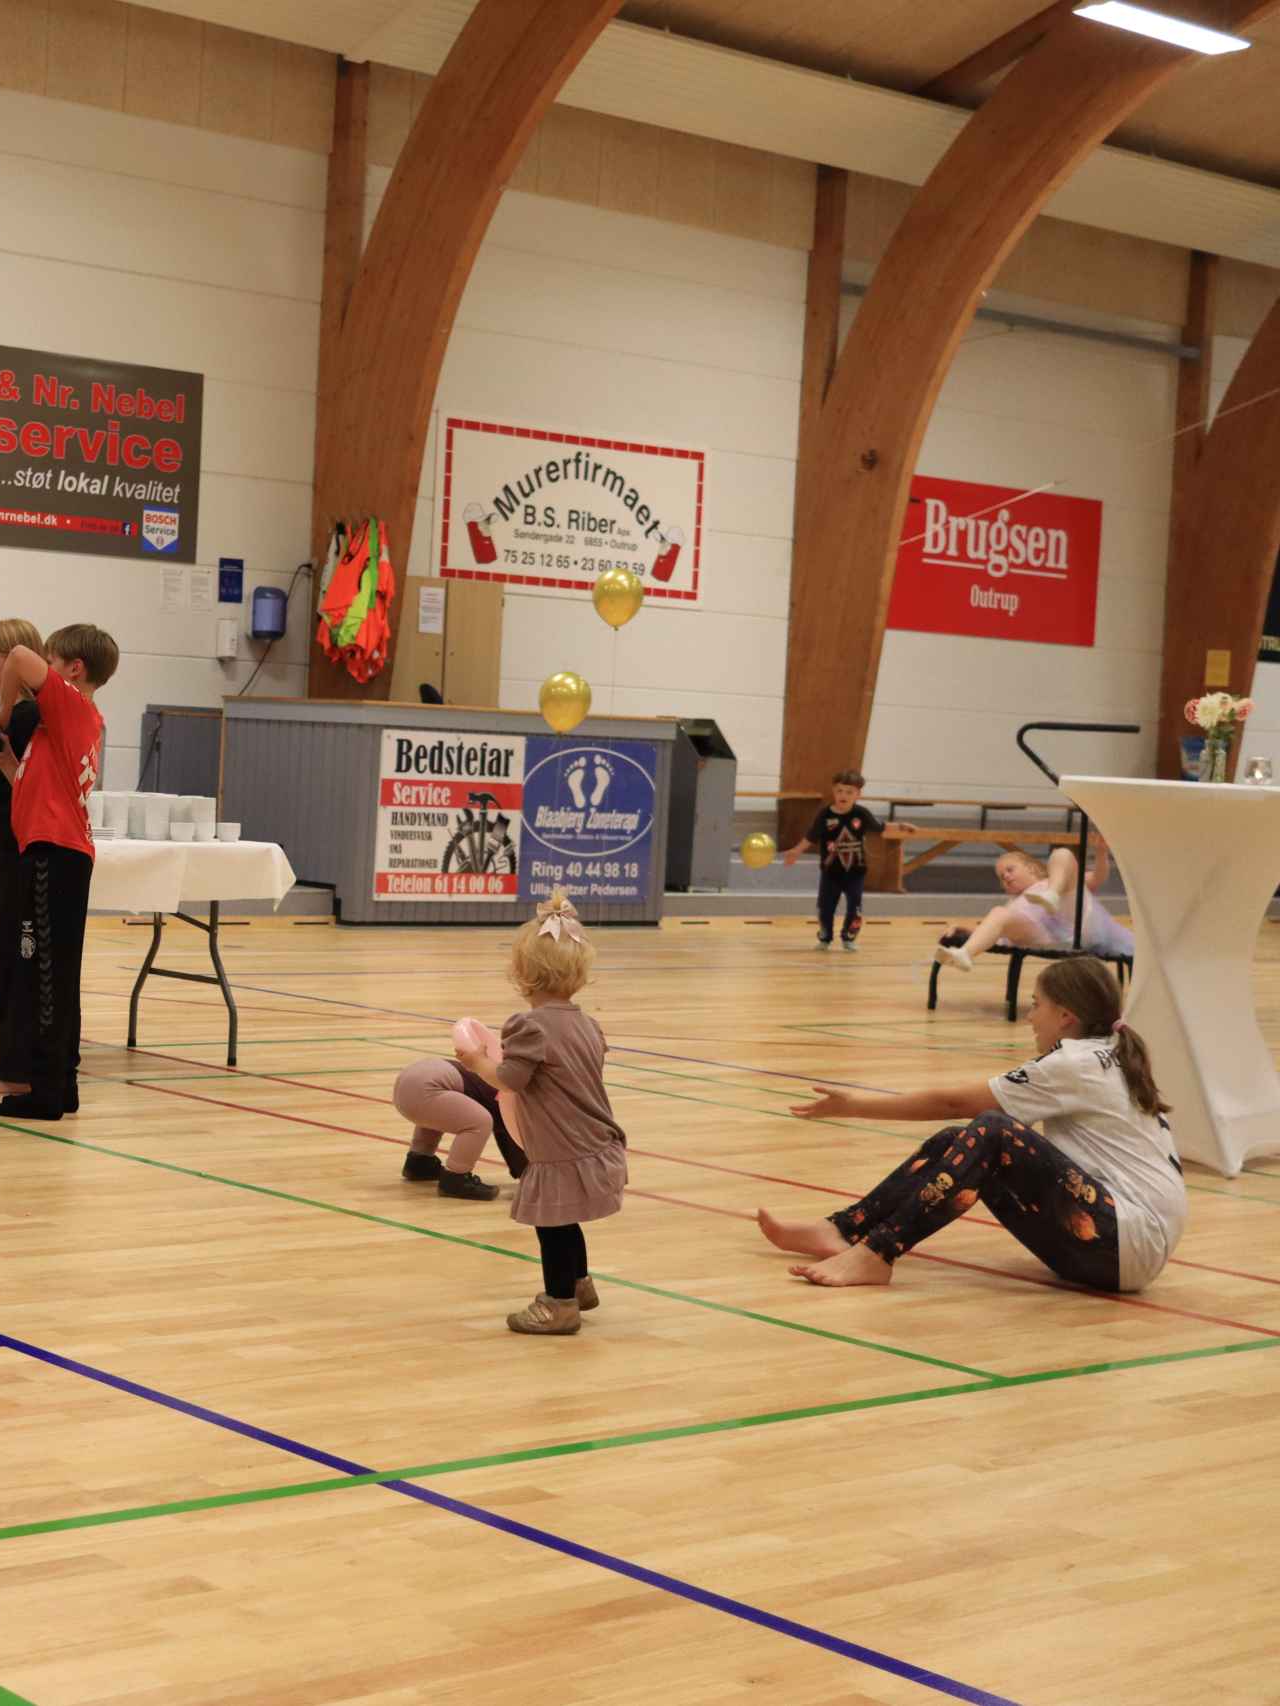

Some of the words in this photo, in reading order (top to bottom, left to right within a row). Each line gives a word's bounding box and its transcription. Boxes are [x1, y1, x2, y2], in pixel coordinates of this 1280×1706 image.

[33, 373, 80, 410] Nr.
[91, 382, 185, 424] Nebel
[57, 470, 109, 496] lokal
[113, 477, 181, 504] kvalitet
[493, 451, 661, 538] Murerfirmaet
[144, 513, 177, 525] BOSCH
[144, 525, 177, 537] Service
[523, 504, 561, 529] B.S.
[567, 509, 616, 535] Riber
[923, 498, 1068, 578] Brugsen
[504, 549, 518, 564] 75
[521, 551, 536, 566] 25
[540, 554, 553, 568] 12
[555, 555, 570, 570] 65
[581, 557, 595, 572] 23
[970, 584, 1019, 616] Outrup
[395, 738, 514, 778] Bedstefar
[392, 781, 451, 806] Service
[391, 811, 449, 827] HANDYMAND
[531, 861, 563, 880] Ring
[566, 862, 582, 877] 40
[585, 862, 600, 877] 44
[624, 863, 639, 878] 18
[387, 874, 433, 893] Telefon
[530, 882, 551, 895] Ulla
[590, 883, 638, 897] Pedersen
